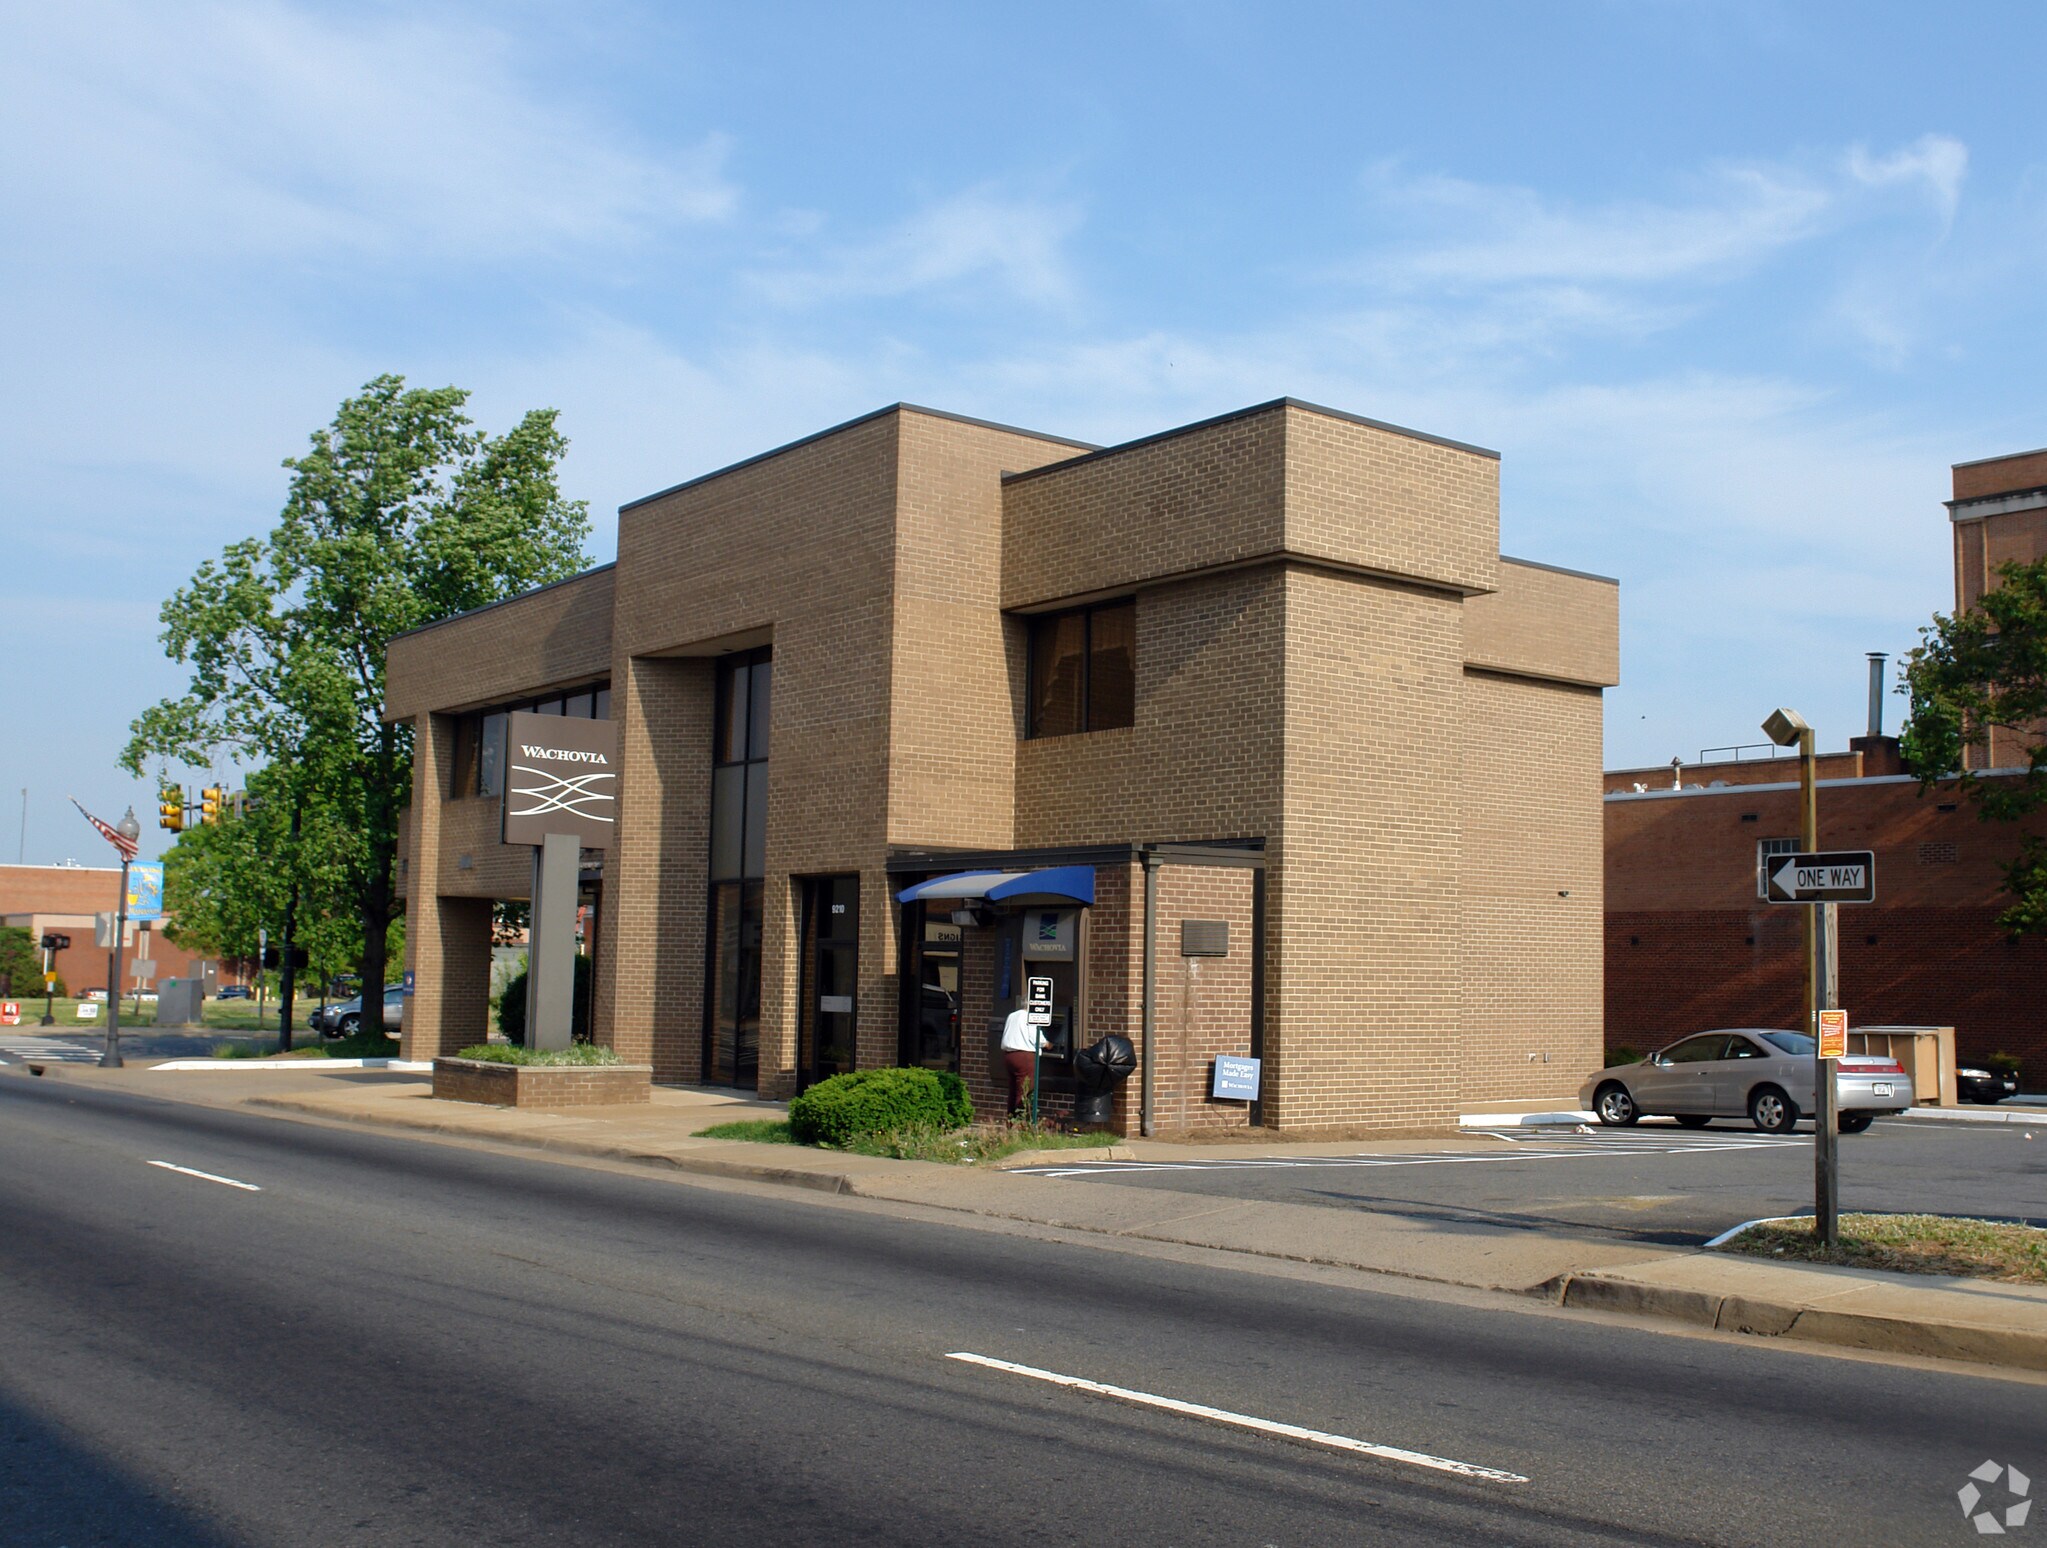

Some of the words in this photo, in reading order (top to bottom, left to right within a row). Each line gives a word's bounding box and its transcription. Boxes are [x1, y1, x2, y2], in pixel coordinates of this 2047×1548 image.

[520, 744, 608, 765] WACHOVIA
[1797, 869, 1826, 887] ONE
[1830, 868, 1860, 886] WAY
[832, 904, 845, 913] 9210
[1029, 943, 1066, 952] WACHOVIA
[1223, 1061, 1254, 1072] Mortgages
[1222, 1069, 1240, 1078] Made
[1240, 1071, 1254, 1081] Easy
